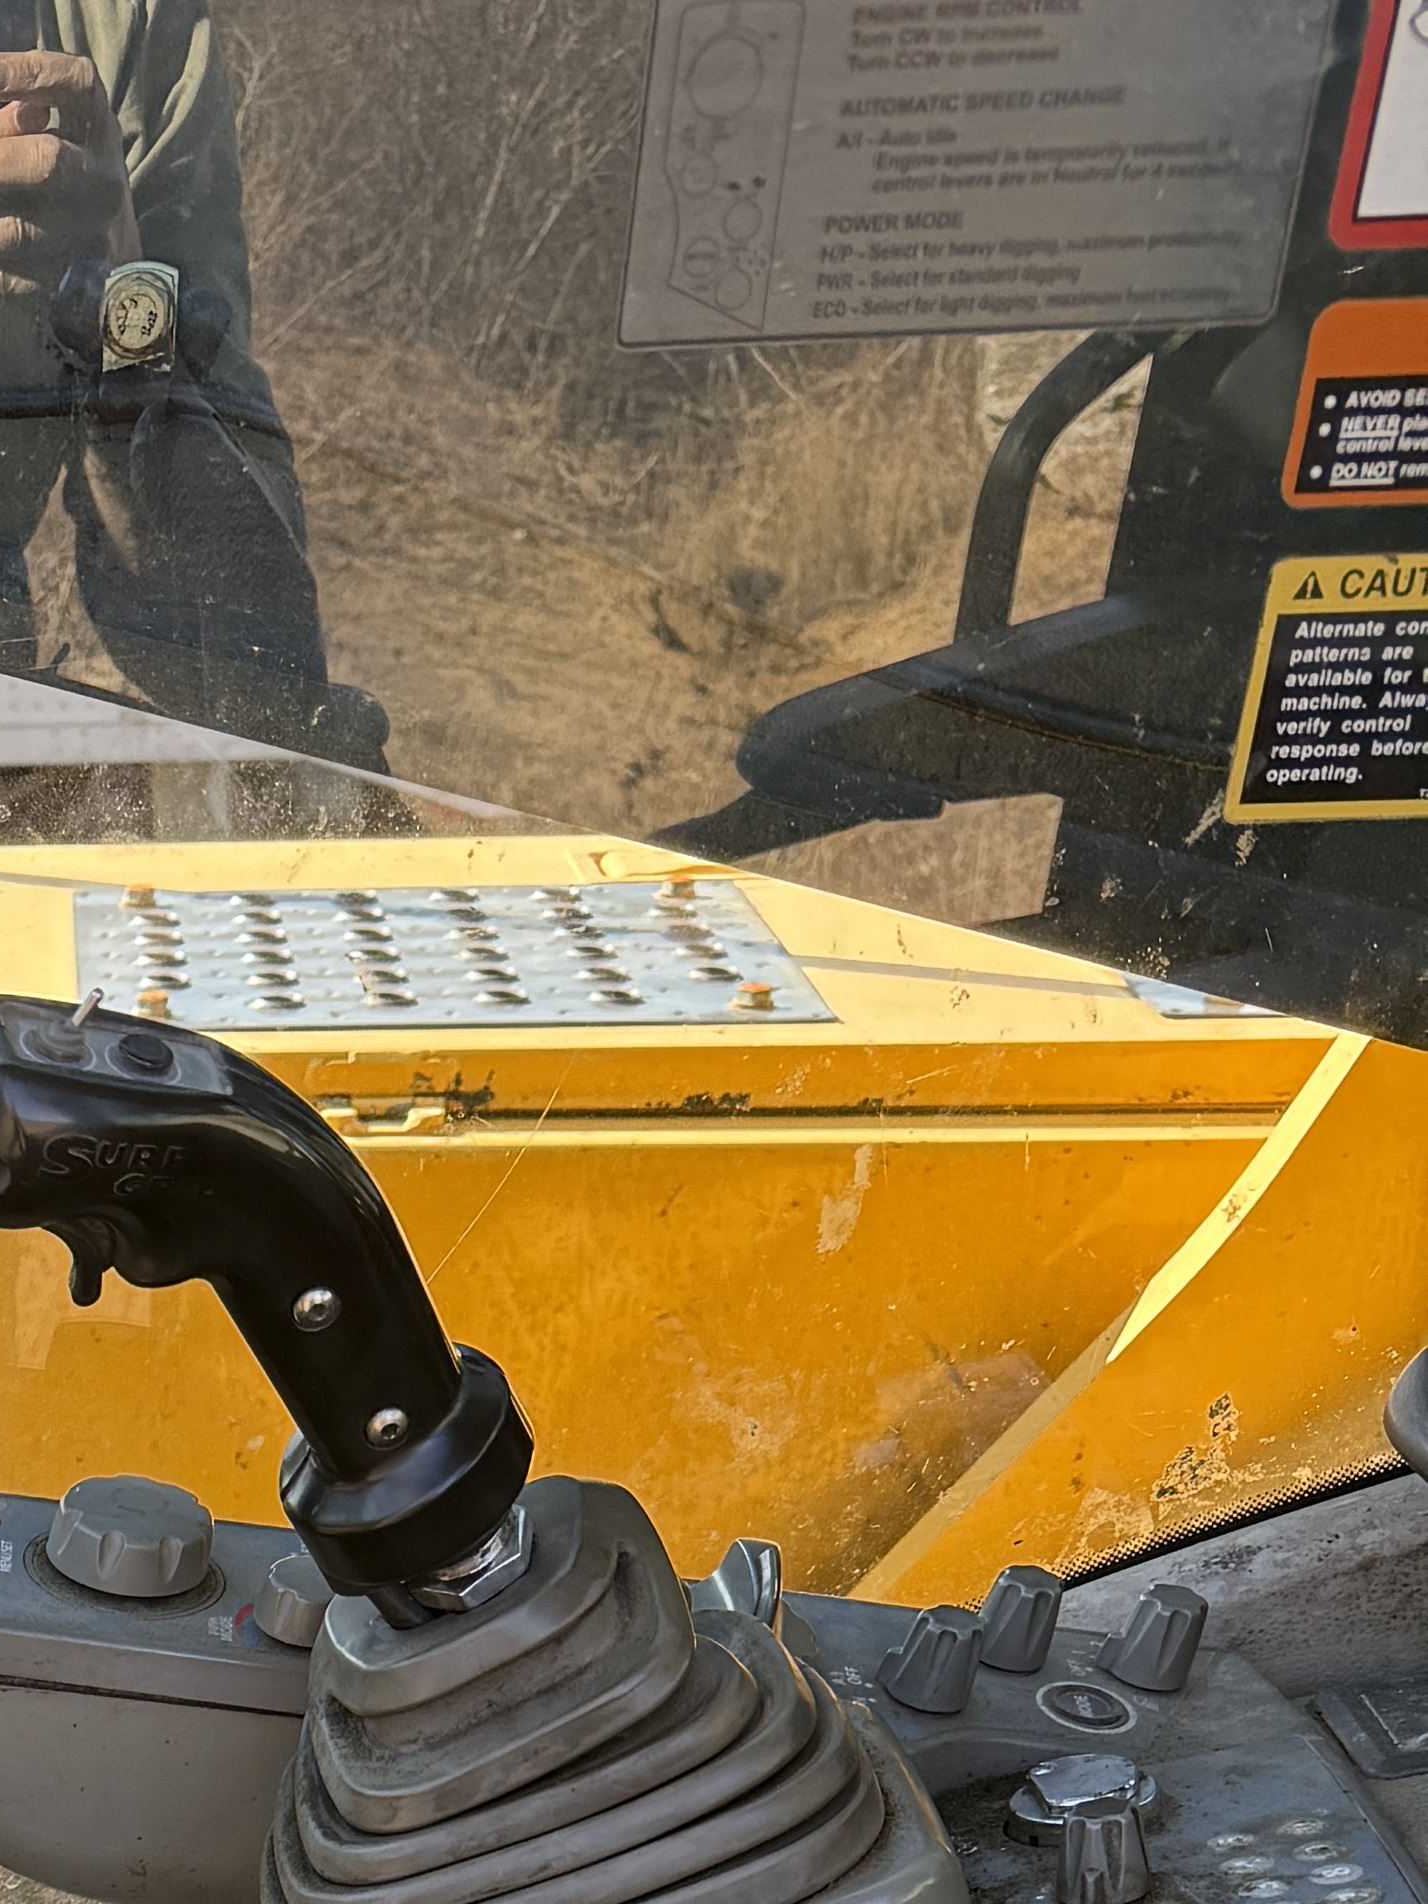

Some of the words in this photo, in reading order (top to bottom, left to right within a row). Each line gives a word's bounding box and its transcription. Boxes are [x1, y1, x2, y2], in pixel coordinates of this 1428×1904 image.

[840, 94, 960, 117] AUTOMATIC
[965, 90, 1034, 112] SPEED
[1039, 85, 1125, 107] CHANGE
[824, 211, 899, 234] POWER
[903, 210, 963, 230] MODE
[813, 300, 846, 319] ECO
[1345, 389, 1401, 409] AVOID
[1340, 414, 1401, 434] NEVER
[1336, 436, 1394, 454] control
[1331, 462, 1358, 479] DO
[1360, 461, 1399, 479] NOT
[1295, 620, 1385, 639] Alternate
[1289, 647, 1370, 667] patterns
[1381, 646, 1413, 661] are
[1285, 669, 1372, 687] available
[1383, 667, 1412, 685] for
[1280, 693, 1367, 712] machine.
[1378, 691, 1428, 710] Alwa
[1276, 716, 1331, 738] verify
[1341, 714, 1412, 734] control
[1270, 743, 1360, 761] response
[1266, 764, 1363, 785] operating.
